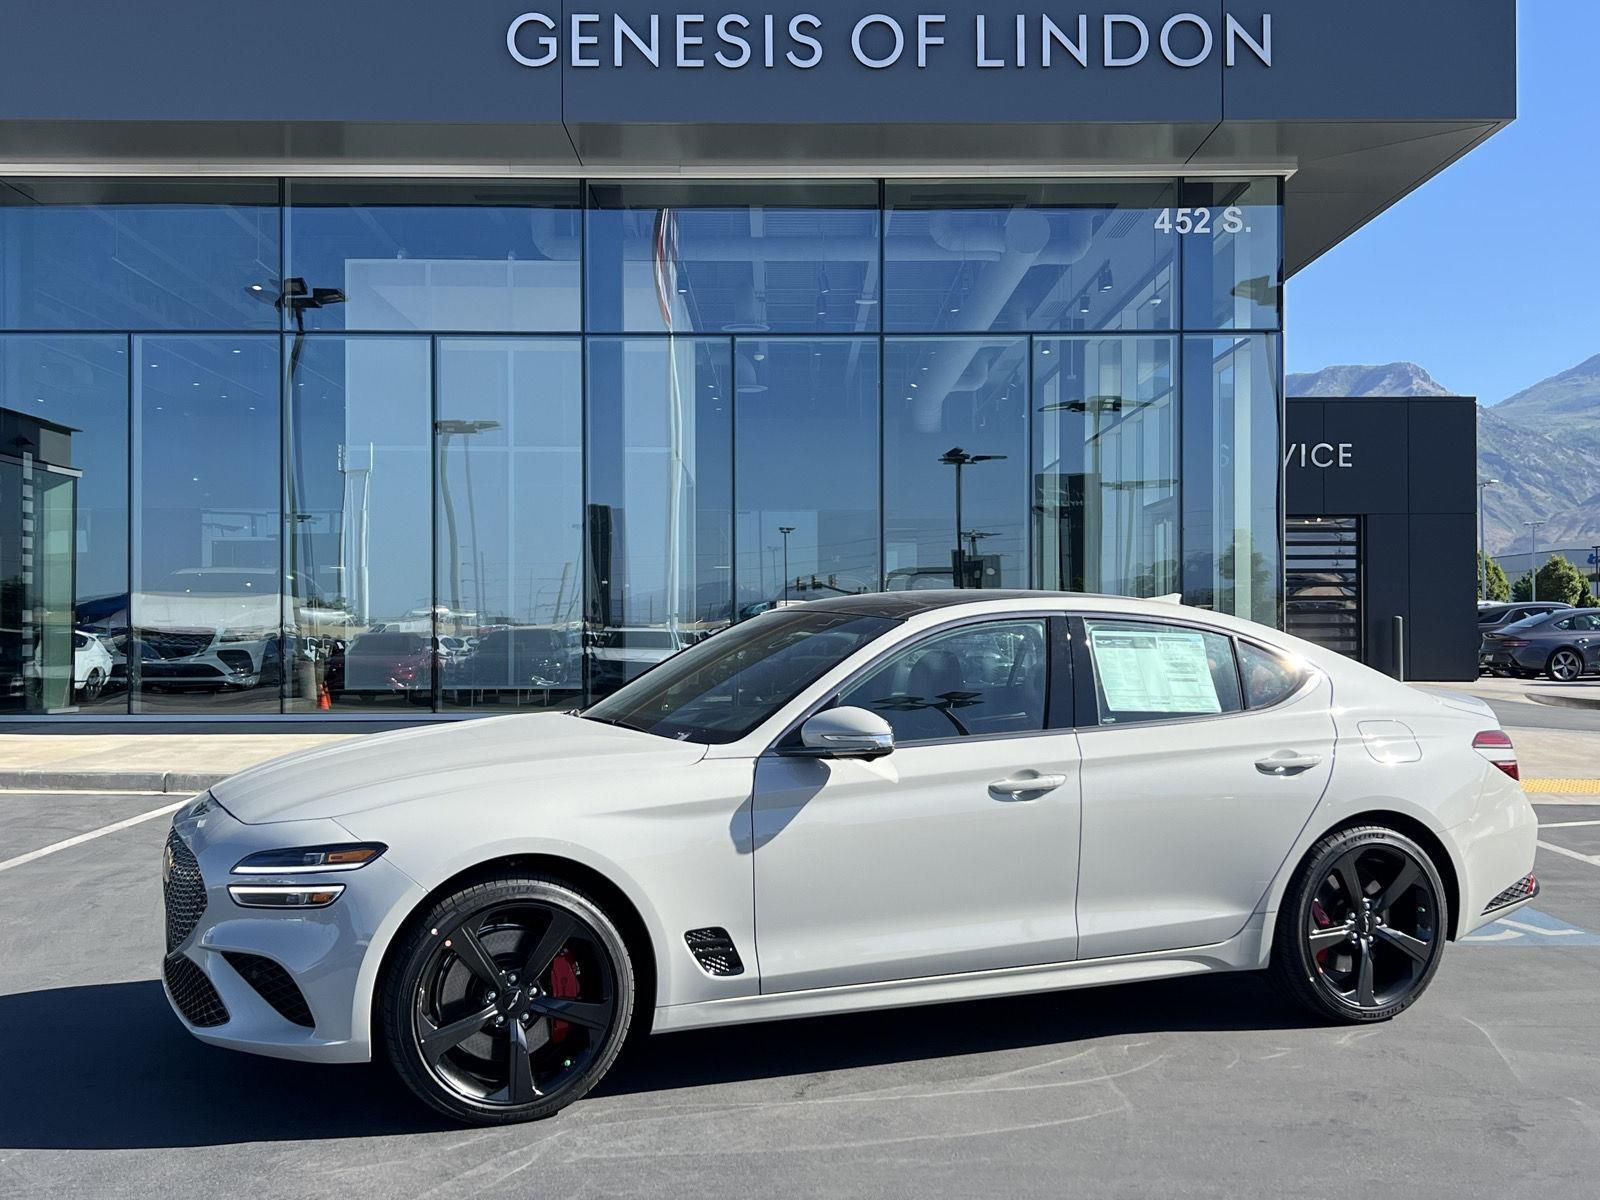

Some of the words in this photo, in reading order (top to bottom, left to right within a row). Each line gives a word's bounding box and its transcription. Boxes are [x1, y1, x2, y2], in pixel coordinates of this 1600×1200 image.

[506, 12, 823, 68] GENESIS
[851, 13, 946, 68] OF
[976, 13, 1272, 68] LINDON
[1154, 207, 1211, 234] 452
[1222, 206, 1251, 233] S.
